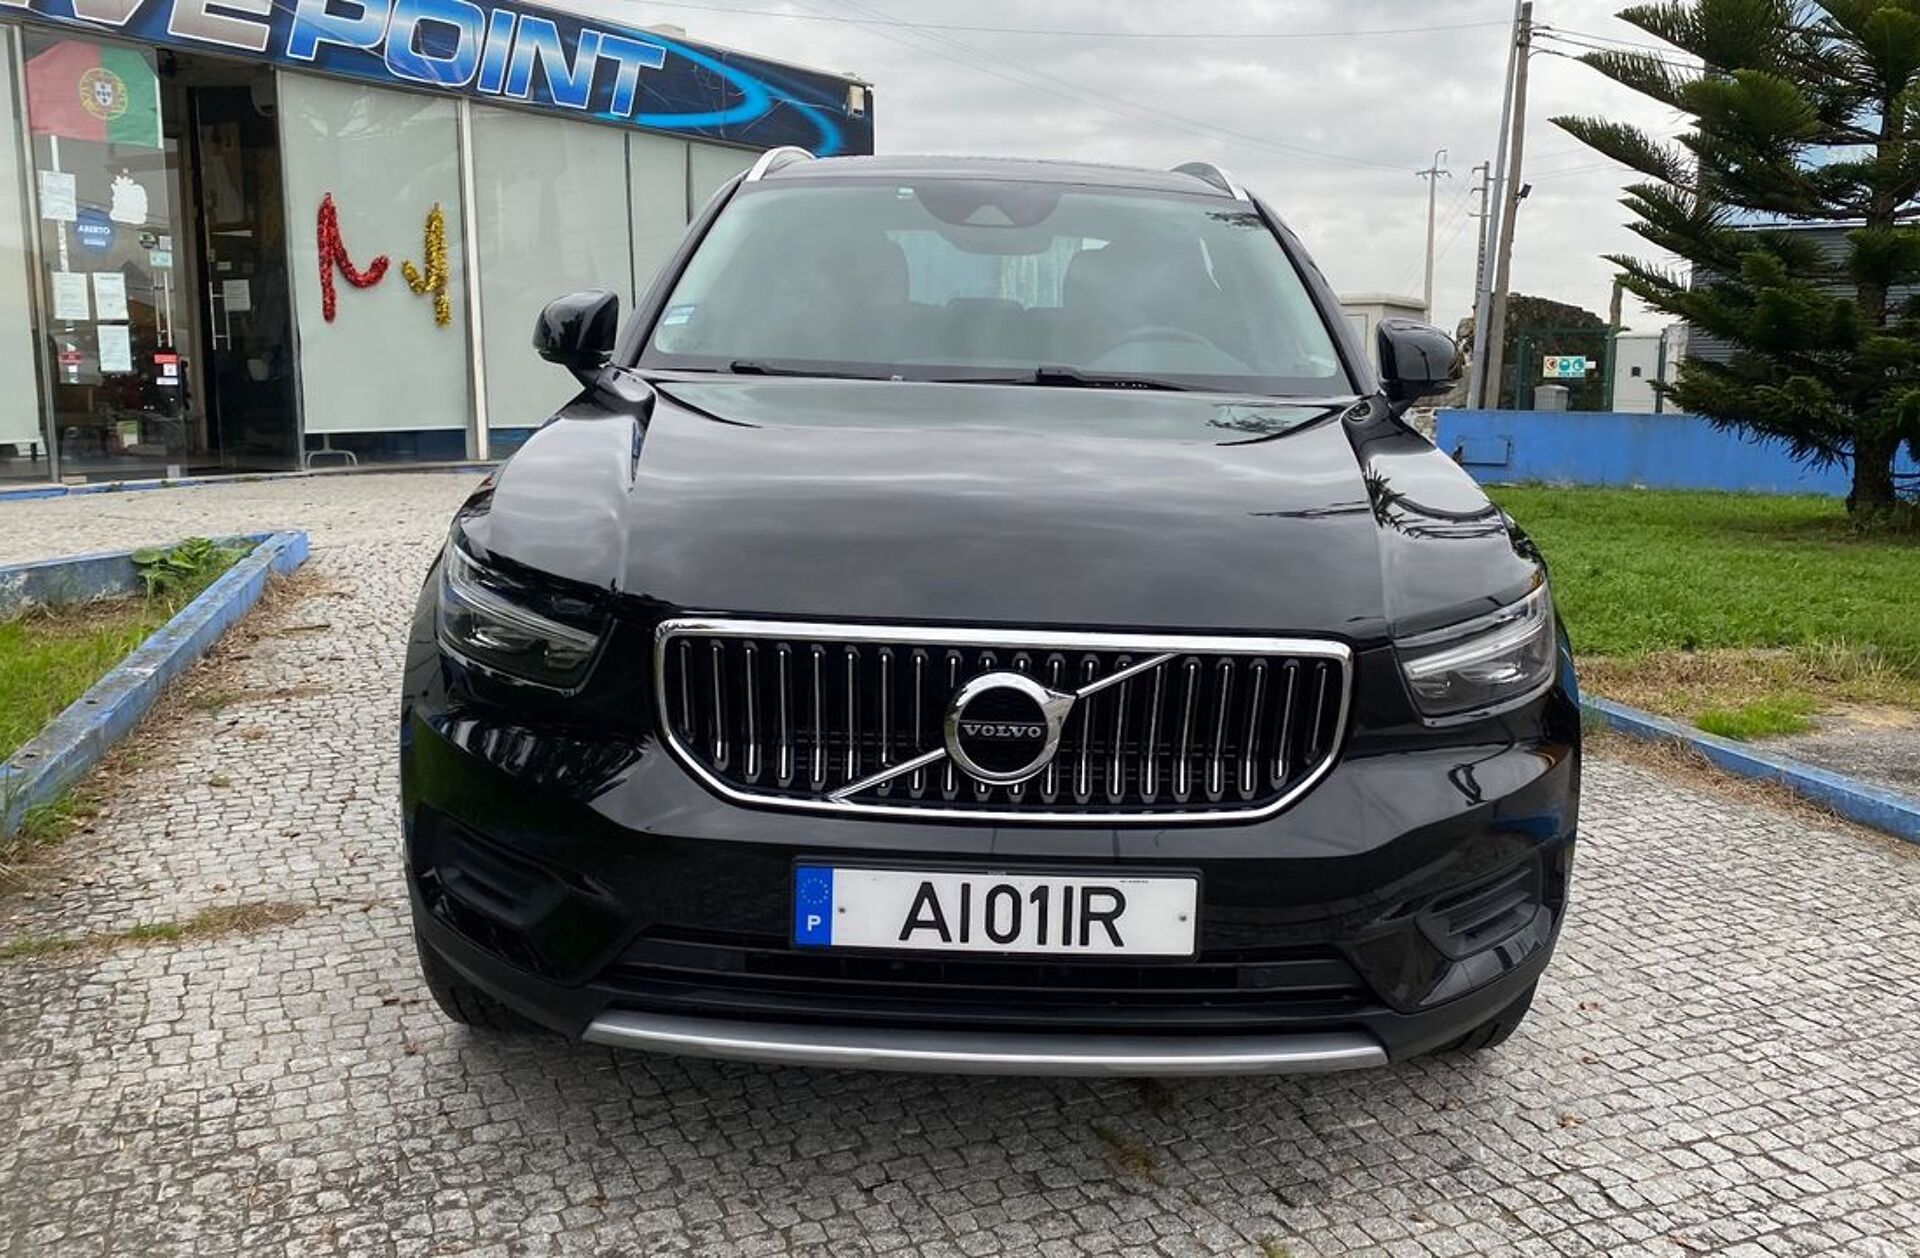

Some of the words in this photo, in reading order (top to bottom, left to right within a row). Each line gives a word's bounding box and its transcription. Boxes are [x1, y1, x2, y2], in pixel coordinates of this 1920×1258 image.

[287, 0, 667, 117] POINT
[962, 724, 1042, 738] VOLVO
[806, 915, 822, 931] P
